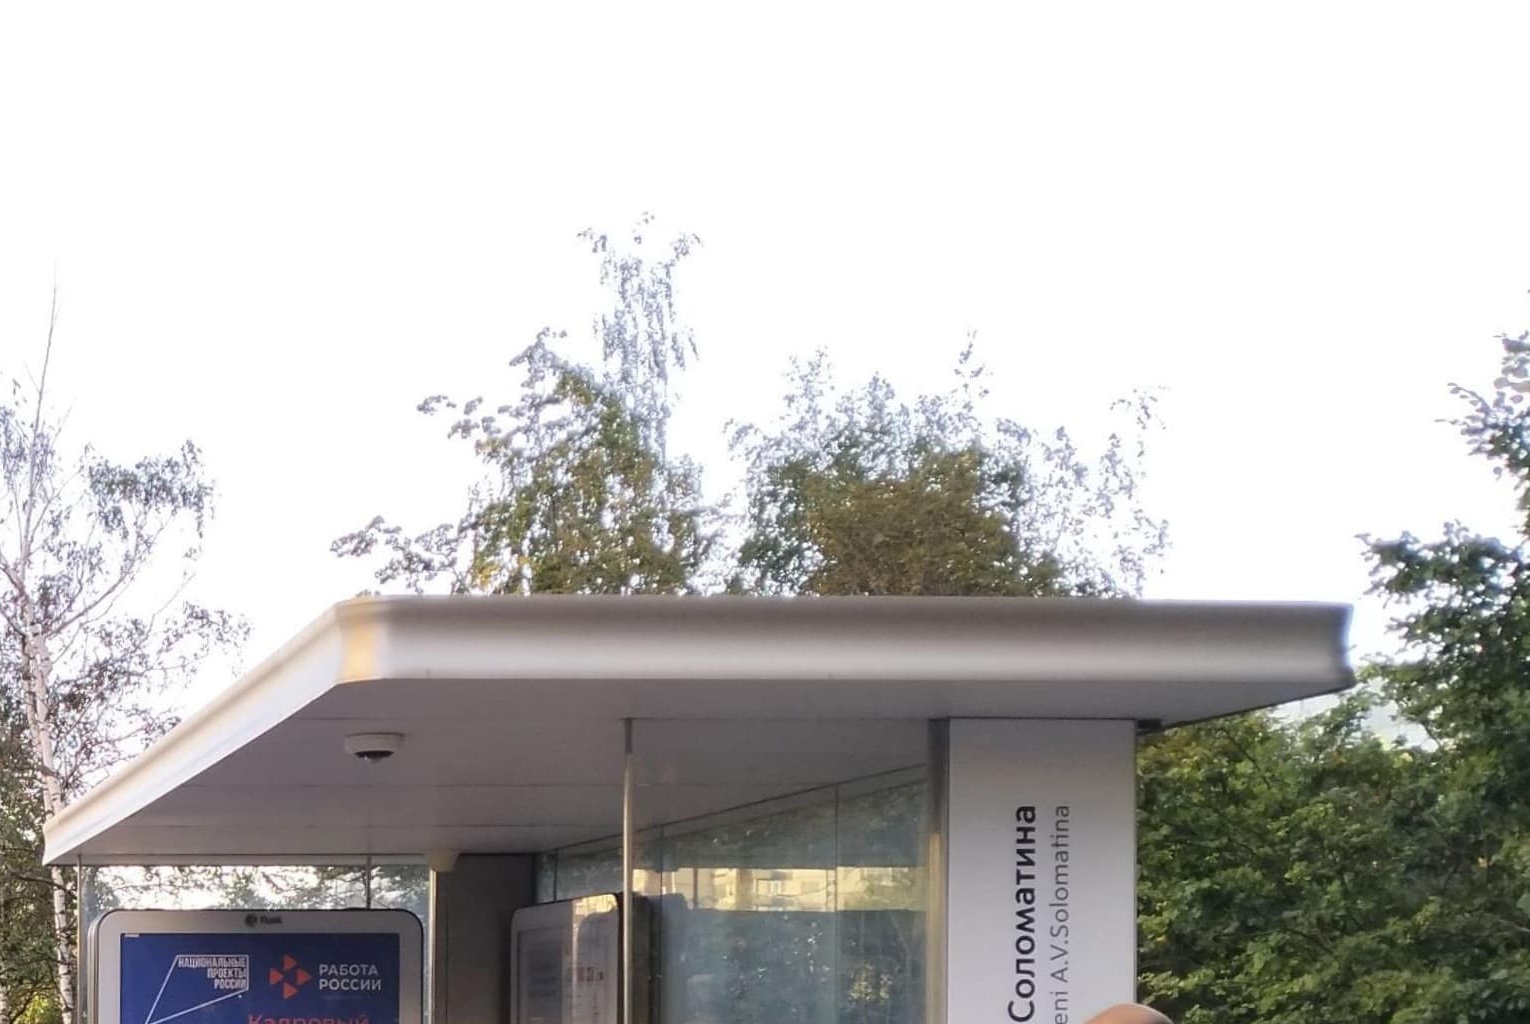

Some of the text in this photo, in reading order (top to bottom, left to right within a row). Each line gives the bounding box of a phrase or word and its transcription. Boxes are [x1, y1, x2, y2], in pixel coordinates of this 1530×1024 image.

[1049, 805, 1070, 983] A.V.Solomatina
[178, 958, 246, 968] НАЦИОНАЛЬНЫЕ
[207, 968, 246, 978] ПРОЕКТЫ
[319, 964, 378, 976] РАБОТА
[214, 979, 246, 989] РОССИИ
[319, 978, 381, 990] РОССИИ
